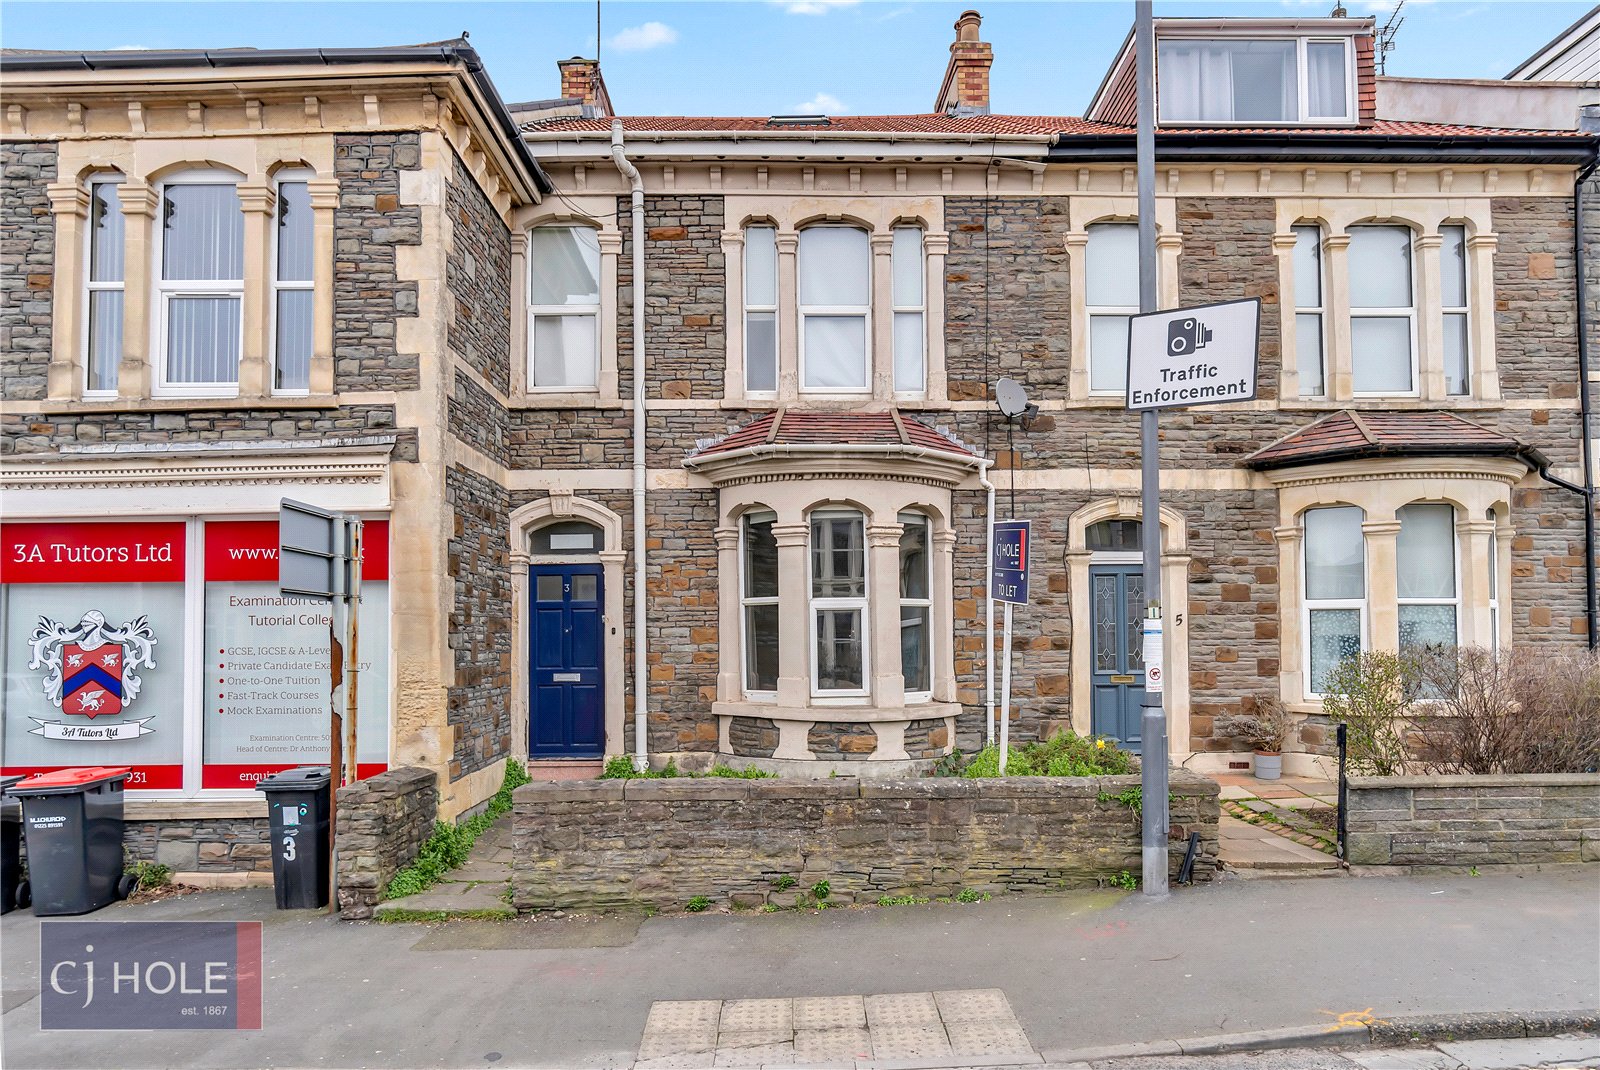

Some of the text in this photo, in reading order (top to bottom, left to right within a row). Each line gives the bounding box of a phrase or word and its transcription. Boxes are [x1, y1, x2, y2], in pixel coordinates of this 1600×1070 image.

[1160, 364, 1218, 382] Traffic
[1132, 379, 1246, 404] Enforcement
[13, 543, 172, 563] 3A Tutors Ltd
[1002, 543, 1020, 557] HOLE
[564, 583, 570, 592] 3
[998, 584, 1017, 597] TO LET
[229, 595, 306, 607] Examination
[248, 614, 333, 627] Tutorial Colleg
[1175, 614, 1183, 626] 5
[227, 646, 331, 656] GCSE, IGCSE & A-Leve
[227, 661, 262, 670] Private
[263, 661, 313, 670] Candidate
[314, 661, 332, 670] Exa
[227, 676, 321, 685] One-to-One Tuition
[227, 691, 319, 700] Fast-Track Courses
[227, 706, 323, 715] Mock Examinations
[61, 727, 118, 739] 3A Tutors Ltd
[299, 745, 330, 753] Anthony
[283, 836, 296, 861] 3
